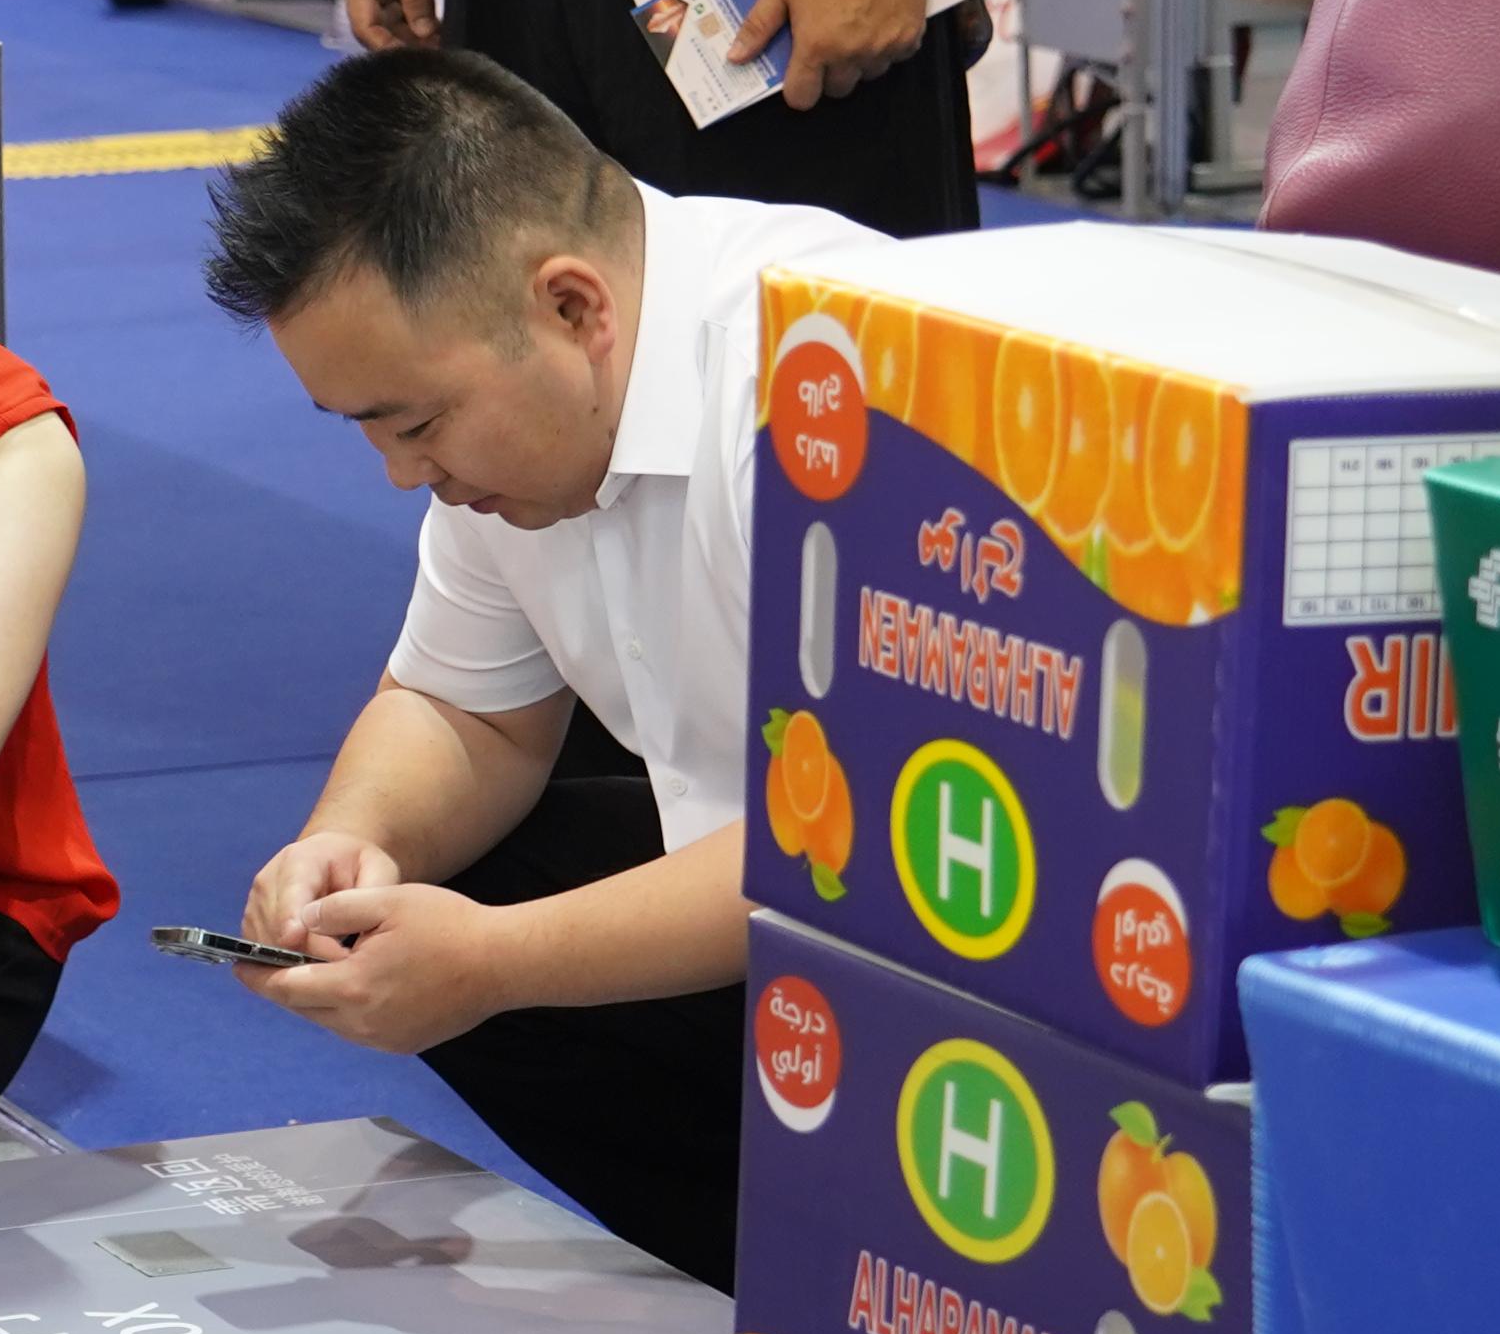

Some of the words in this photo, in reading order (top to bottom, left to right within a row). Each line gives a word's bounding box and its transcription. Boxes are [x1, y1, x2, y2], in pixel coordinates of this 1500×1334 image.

[858, 585, 1083, 740] ALHARAMAEN
[141, 1157, 284, 1216] 需返回
